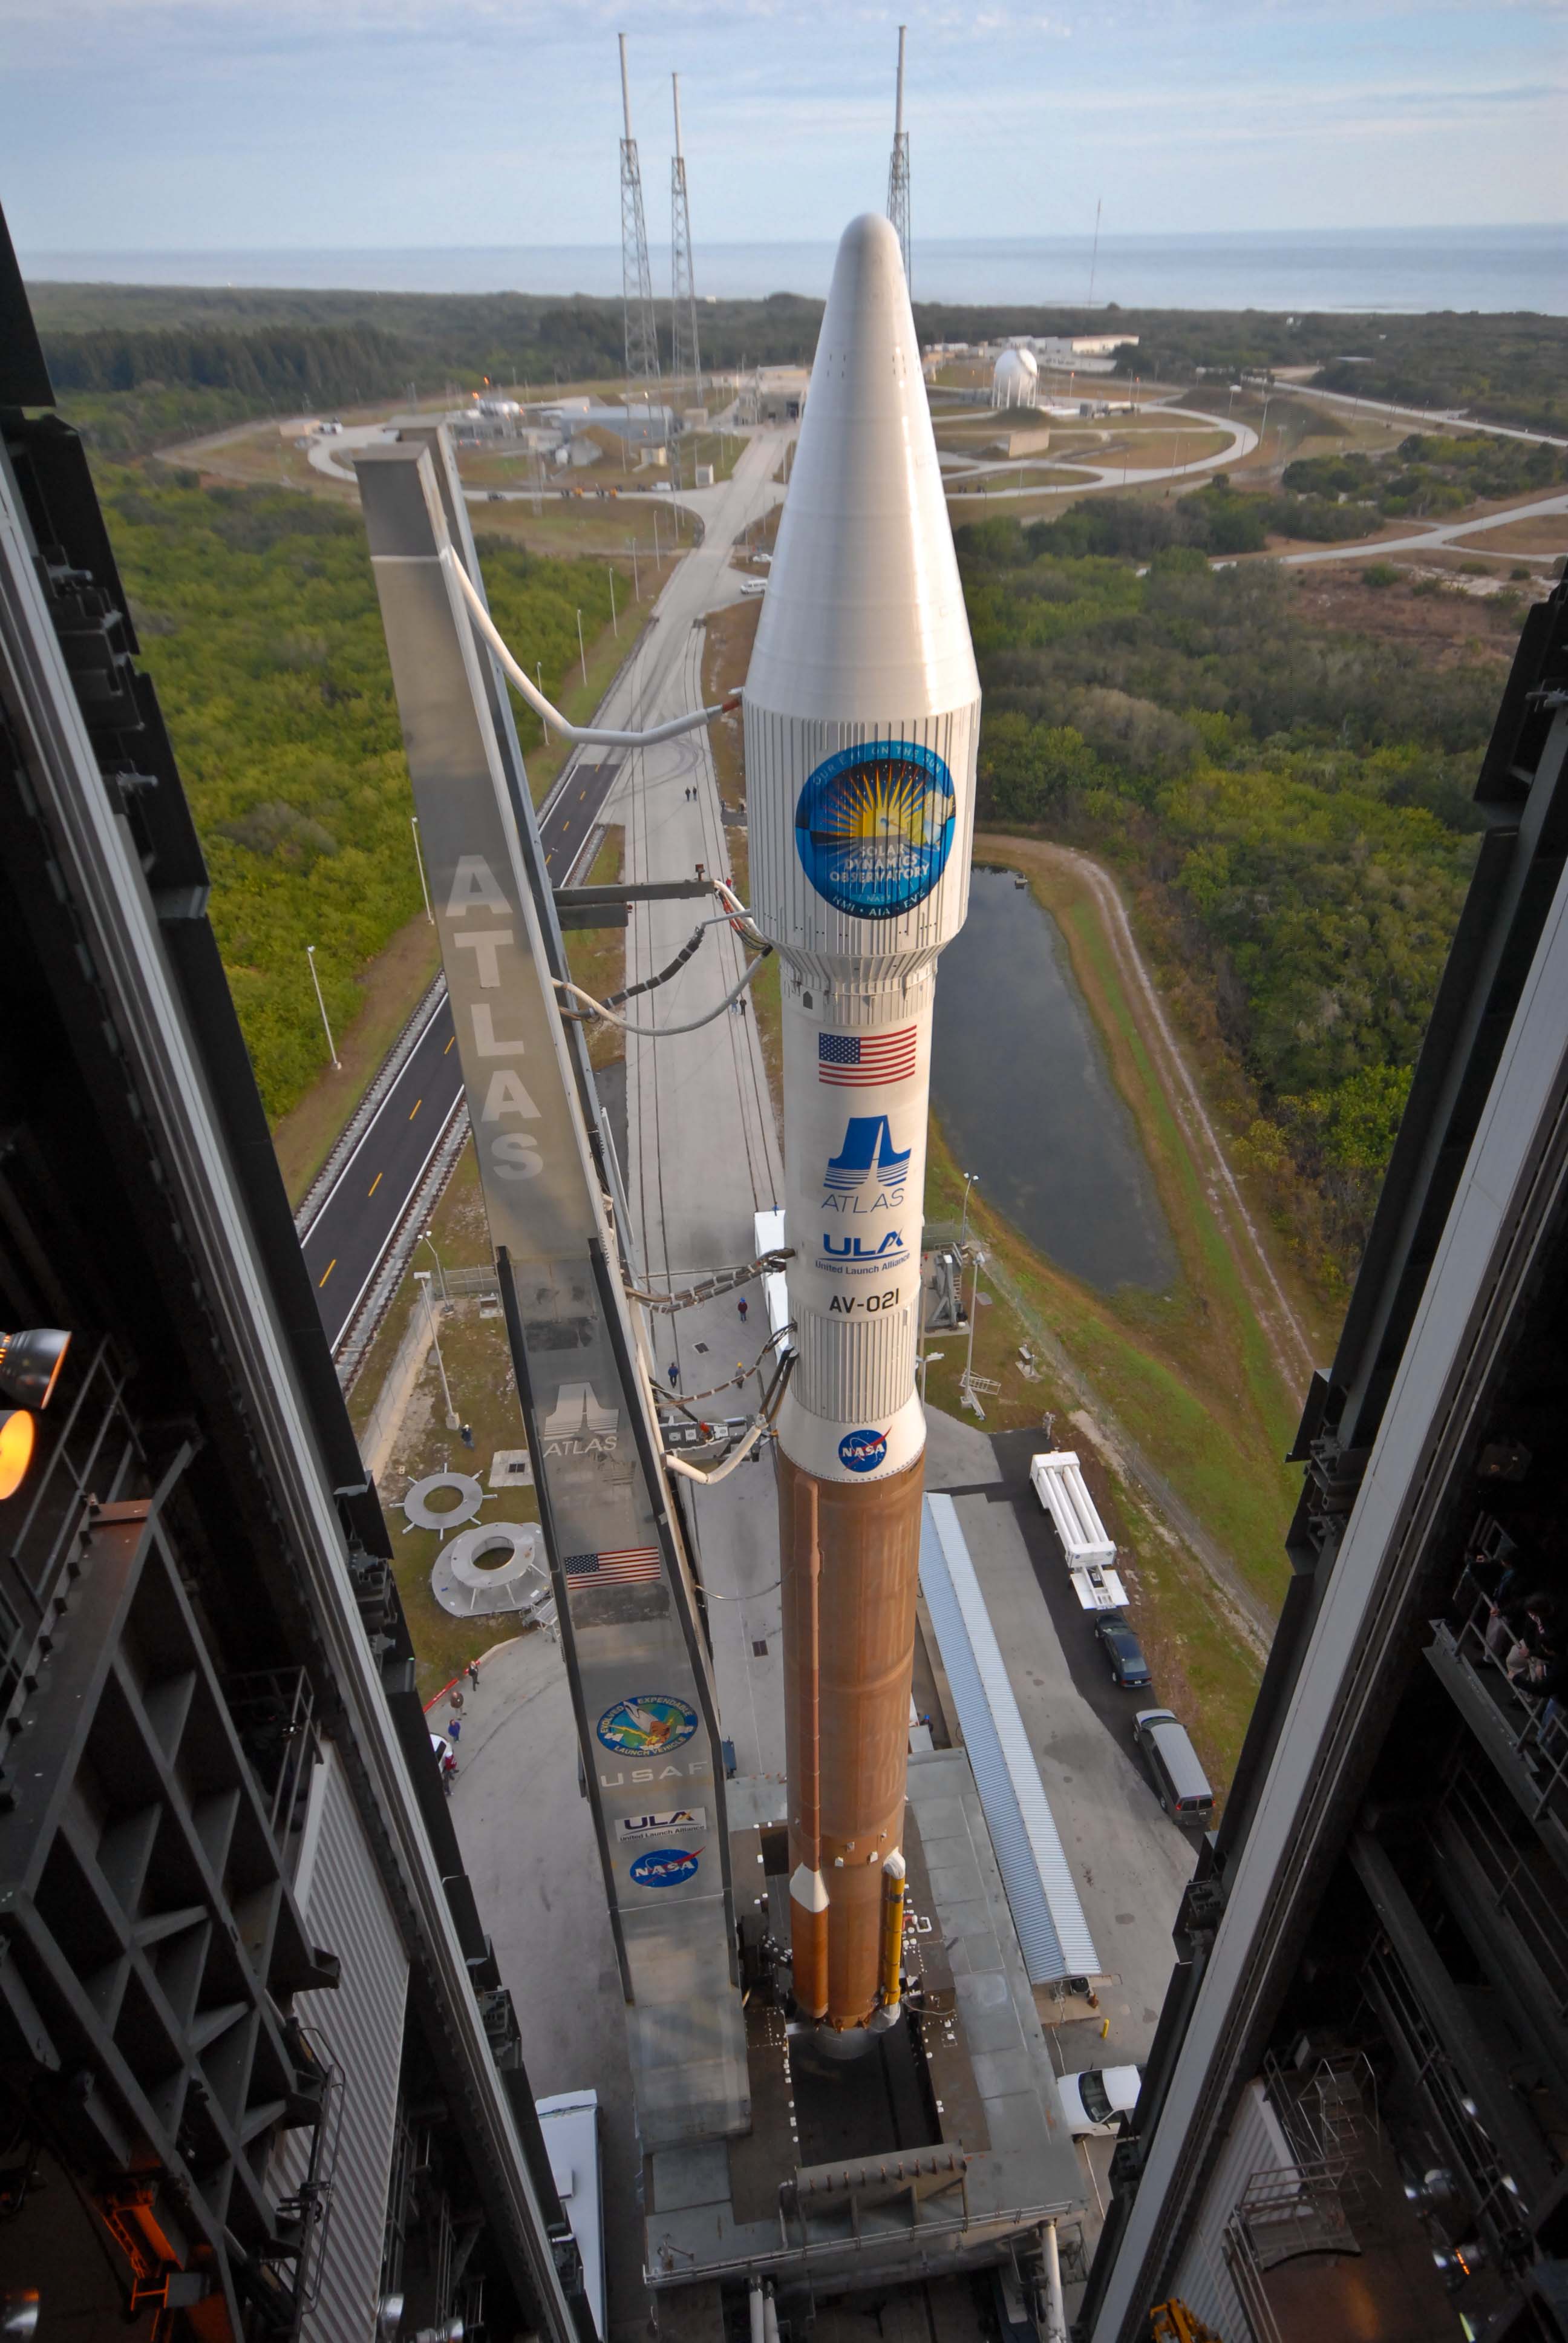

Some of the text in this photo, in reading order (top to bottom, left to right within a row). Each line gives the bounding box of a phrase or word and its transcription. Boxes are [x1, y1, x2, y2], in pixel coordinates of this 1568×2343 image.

[813, 745, 942, 785] OUR ON THE SUN
[860, 844, 905, 857] SOLAR
[845, 854, 918, 870] DYNAMICS
[829, 863, 930, 883] OBSERVATORY
[904, 889, 925, 908] EVE
[445, 855, 543, 1180] ATLAS
[821, 1188, 904, 1213] ATLAS
[823, 1227, 903, 1256] ULA
[815, 1253, 910, 1274] United Launch Alliance
[829, 1288, 900, 1313] AV-021
[543, 1436, 617, 1457] ATLAS
[842, 1443, 885, 1457] NASA
[600, 1697, 693, 1733] EVOLVED EXPENDABLE
[615, 1736, 687, 1755] LAUNCH VEHICLE
[601, 1761, 708, 1786] USAF
[624, 1810, 695, 1830] ULA
[645, 1830, 673, 1838] Launch
[675, 1825, 705, 1834] Alliance
[635, 1861, 695, 1876] NASA
